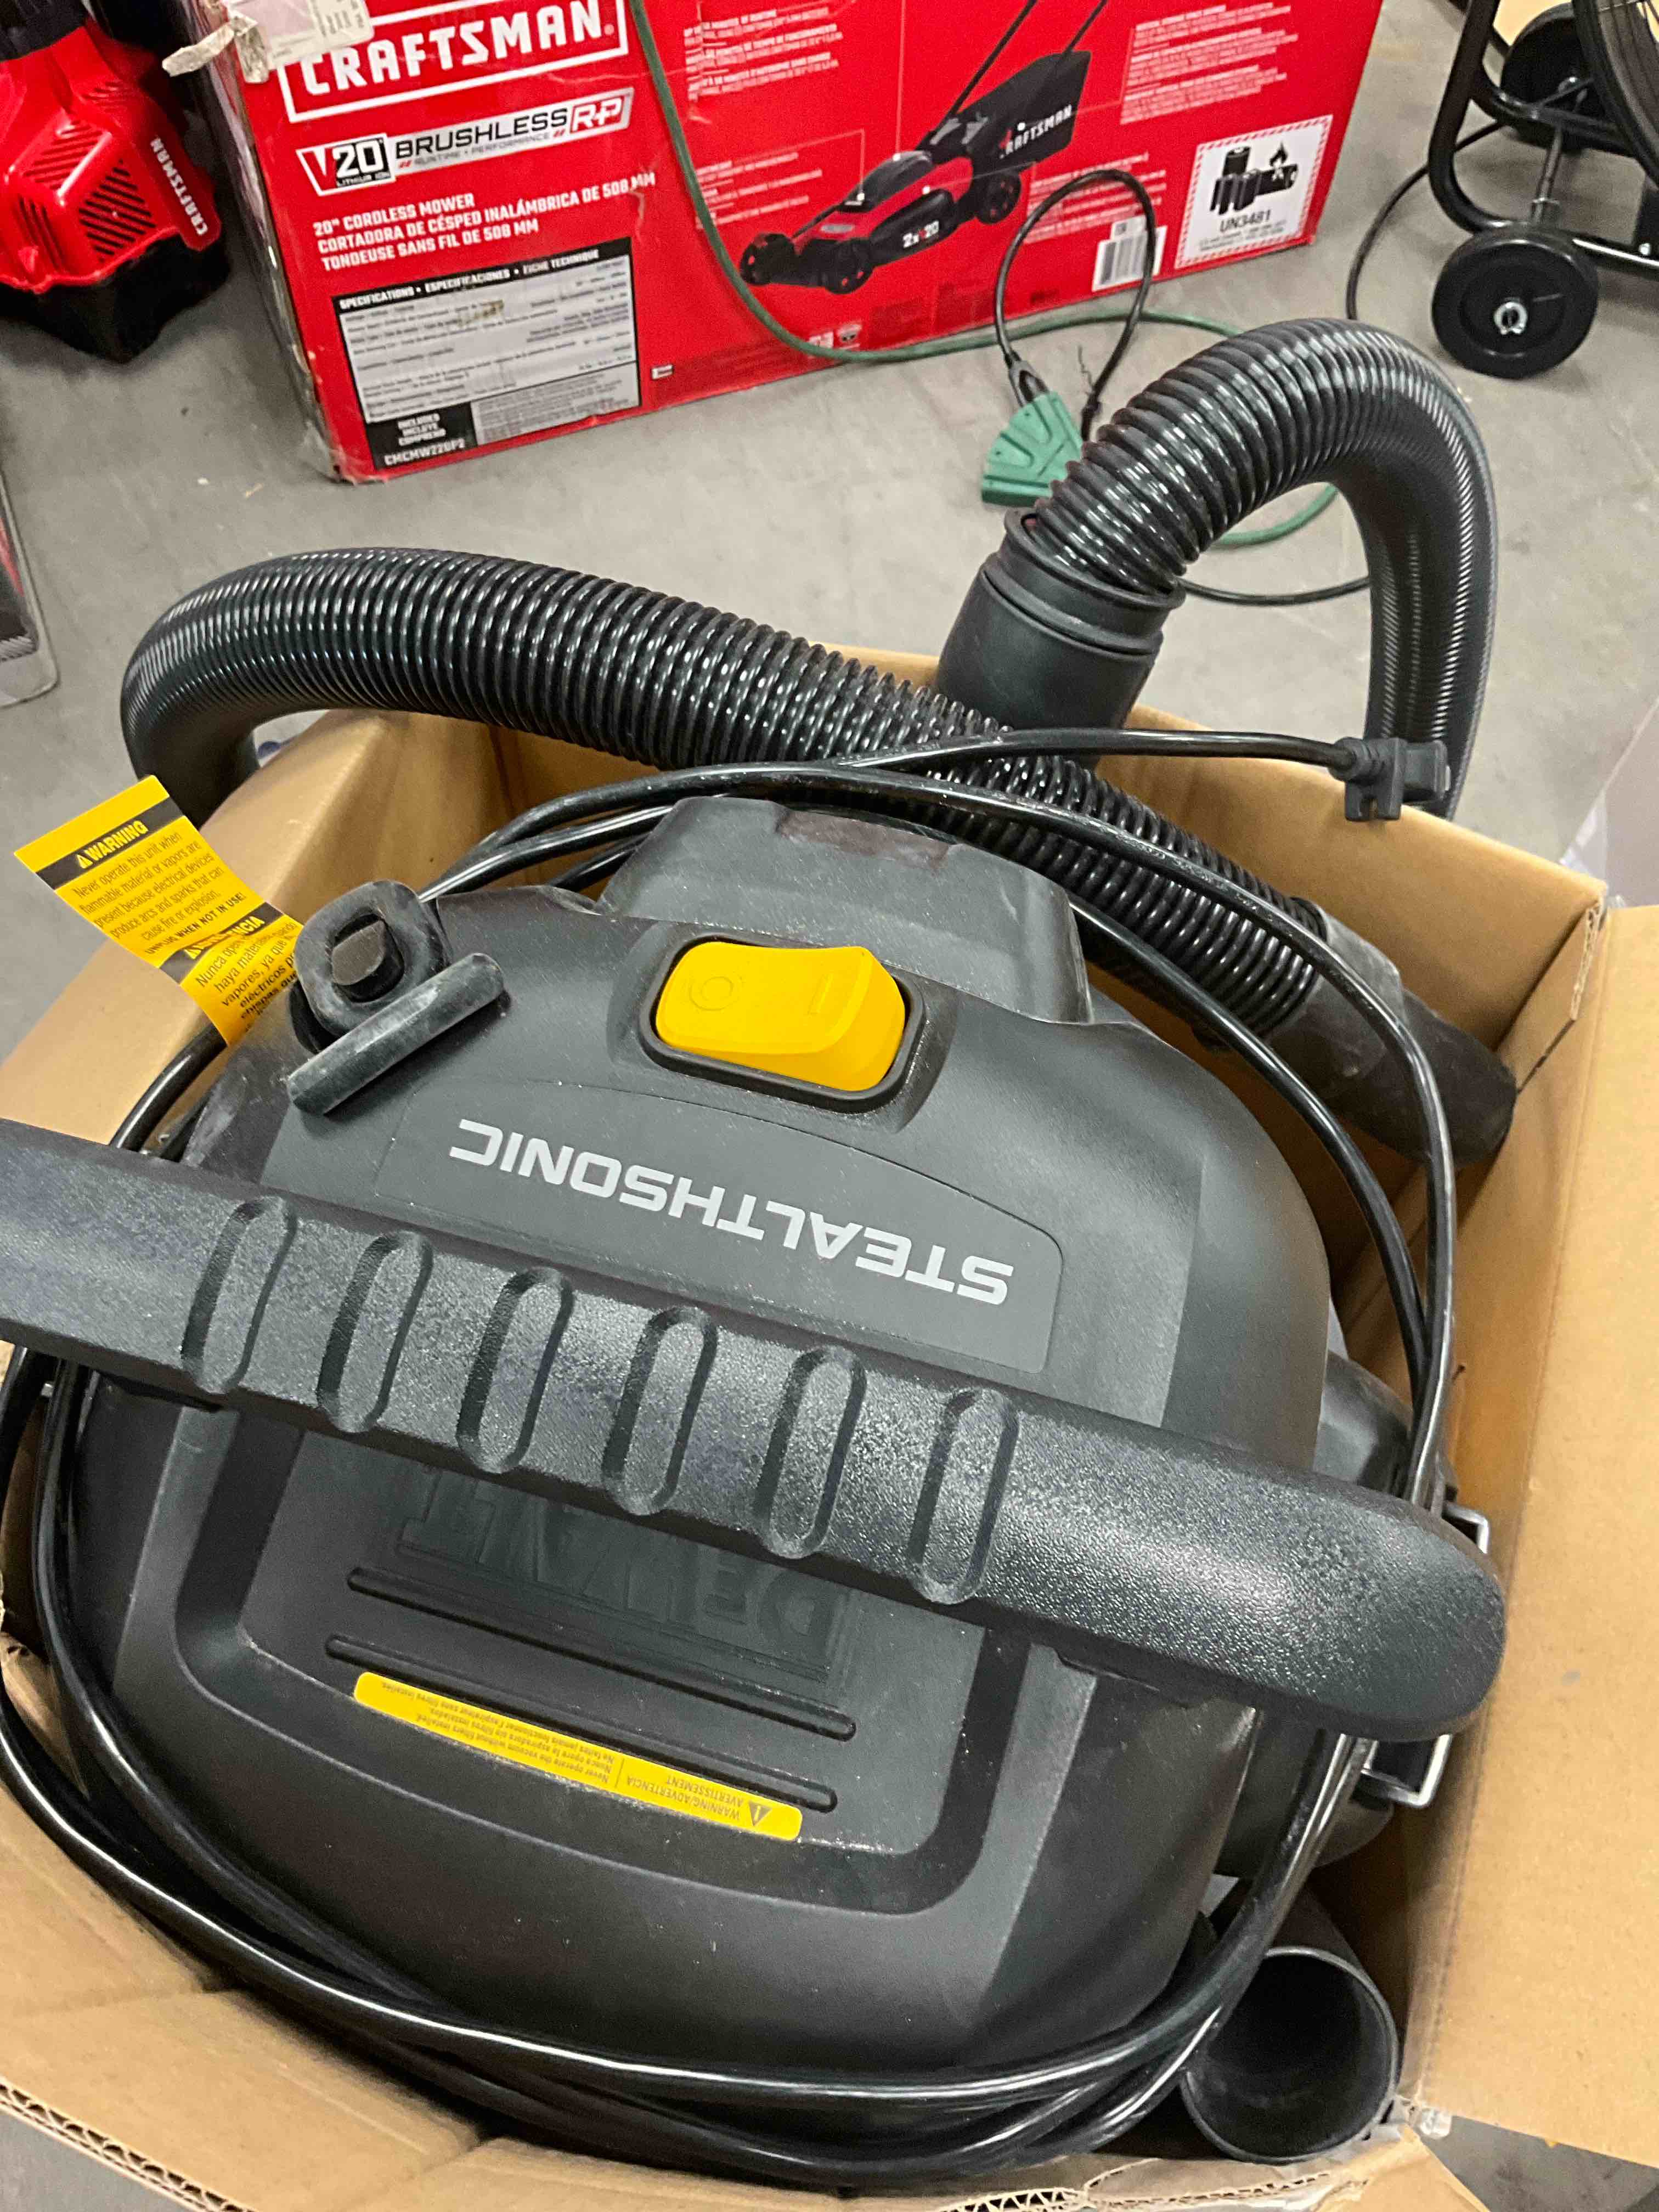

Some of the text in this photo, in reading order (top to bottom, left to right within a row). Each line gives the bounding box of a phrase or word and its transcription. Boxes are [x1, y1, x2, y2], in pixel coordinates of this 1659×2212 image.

[298, 0, 602, 95] CRAFTSMAN
[393, 108, 570, 159] BRUSHLESS
[998, 104, 1072, 159] RAFTSMAN
[150, 137, 208, 235] CRAFTSMAN
[313, 193, 475, 236] 20" CORDLESS MOWER
[318, 172, 656, 254] CORTADORA DE CÉSPED INALÁMBRICA DE 508 MM
[321, 218, 539, 272] TONDEUSE SANS FIL DE 508 MM
[339, 285, 414, 311] SPECIFICATIONS
[74, 831, 181, 899] Never operate this unit when
[84, 819, 148, 863] WARNING
[80, 841, 200, 915] flammable material or vapors are
[95, 852, 213, 928] present because electrical devices
[111, 866, 223, 940] produce arcs and sparks that can
[142, 923, 163, 941] cause
[160, 913, 176, 928] fire
[176, 911, 184, 920] or
[175, 921, 199, 939] WHEN
[200, 911, 216, 924] NOT
[217, 903, 227, 913] IN
[226, 891, 245, 907] USE!
[197, 952, 227, 988] Nunca
[215, 967, 240, 992] haya
[222, 939, 287, 1006] vapores, ya que
[448, 1119, 1014, 1305] STEALTHSONIC
[538, 1754, 552, 1763] the
[553, 1758, 583, 1772] operate
[583, 1768, 608, 1782] Never
[666, 1775, 743, 1807] AVERTISSEMENT
